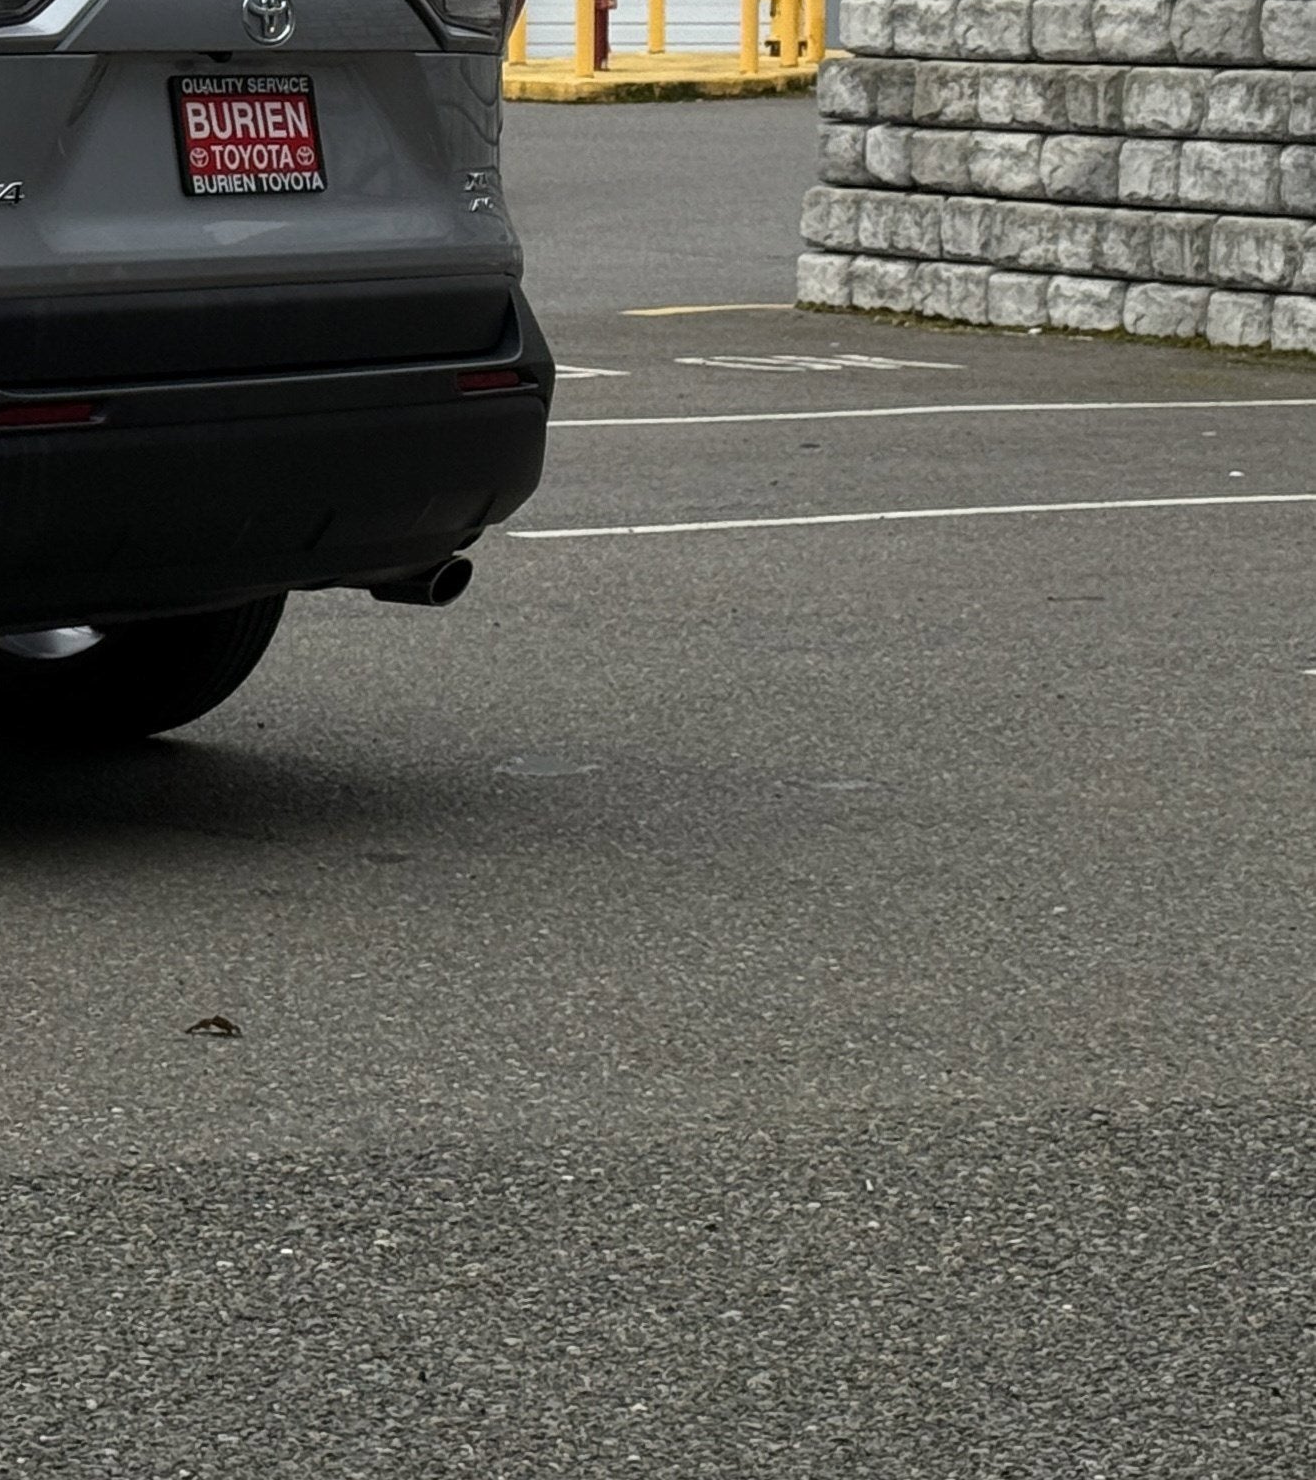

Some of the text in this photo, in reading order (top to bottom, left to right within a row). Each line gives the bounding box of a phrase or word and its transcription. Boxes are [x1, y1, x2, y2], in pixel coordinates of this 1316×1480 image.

[181, 77, 309, 94] QUALITY SERVICE
[185, 101, 309, 139] BURIEN
[210, 144, 295, 170] TOYOTA
[192, 171, 324, 194] BURIEN TOYOTA
